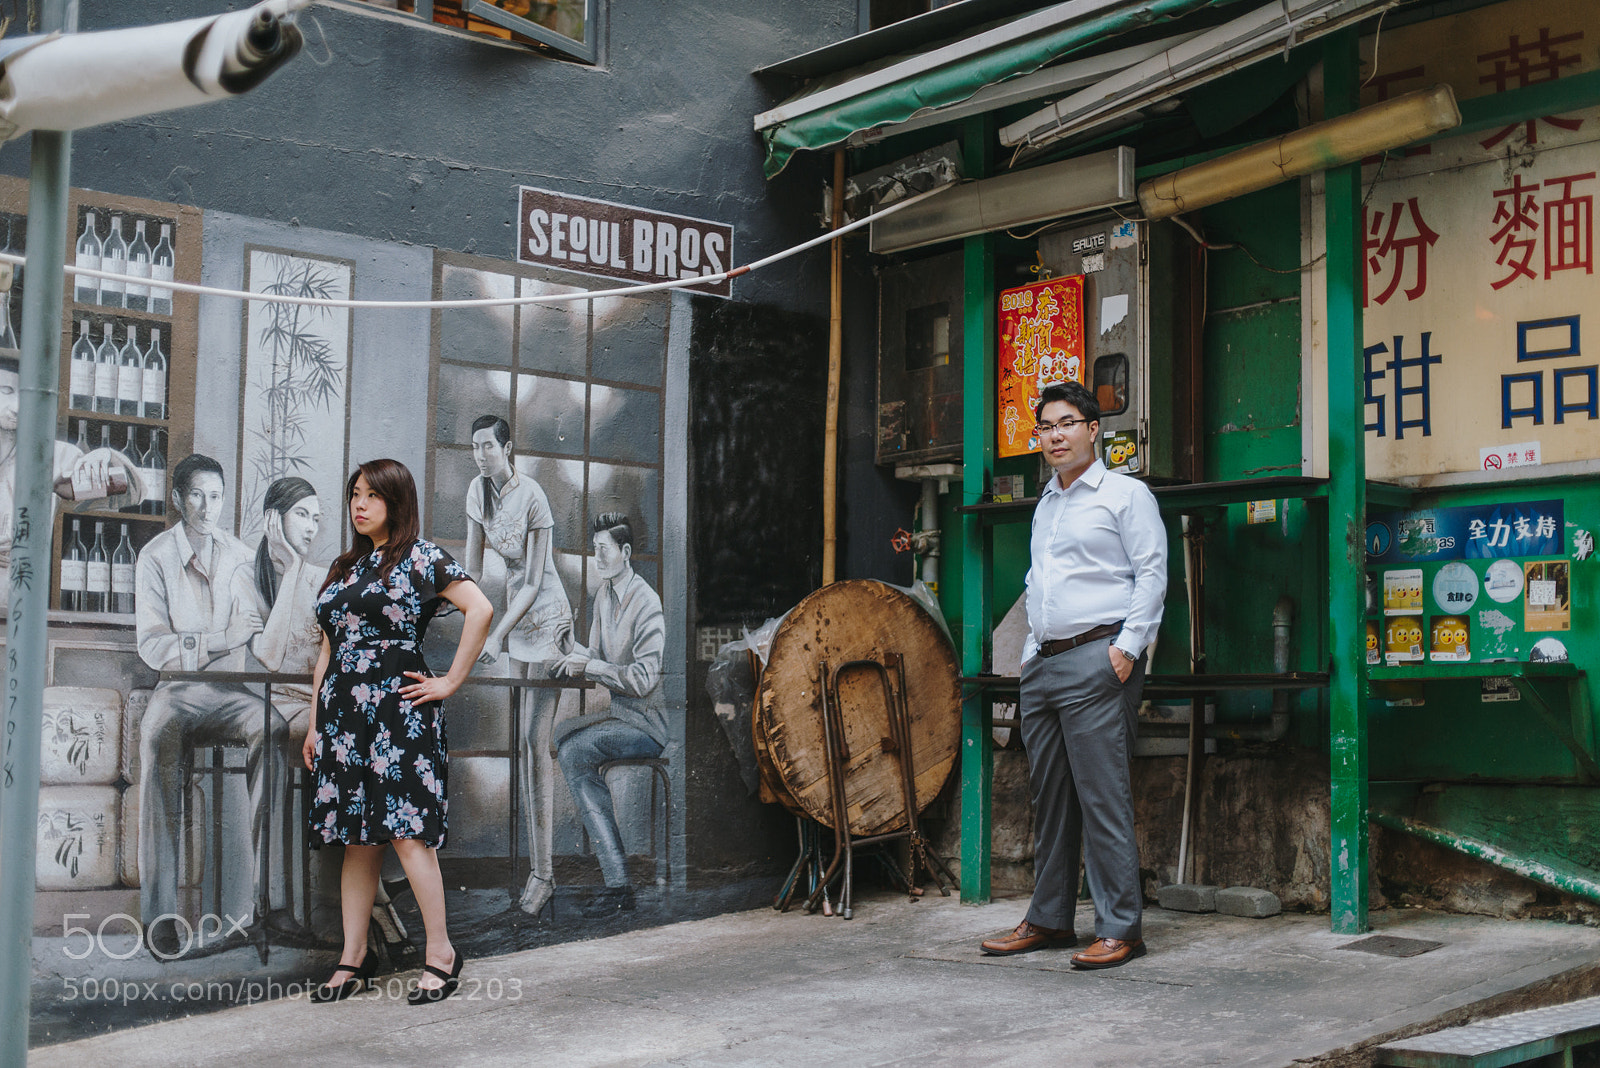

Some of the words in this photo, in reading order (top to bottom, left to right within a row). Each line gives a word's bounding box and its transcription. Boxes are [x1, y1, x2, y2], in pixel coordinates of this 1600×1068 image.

[528, 208, 626, 270] SEOUL
[633, 218, 725, 285] BROS
[1002, 290, 1033, 311] 2018
[1035, 287, 1059, 355] 恭賀
[1013, 315, 1038, 376] 新禧
[1363, 314, 1599, 440] 甜品
[1507, 449, 1537, 464] 禁煙
[1469, 515, 1557, 547] 全力支持
